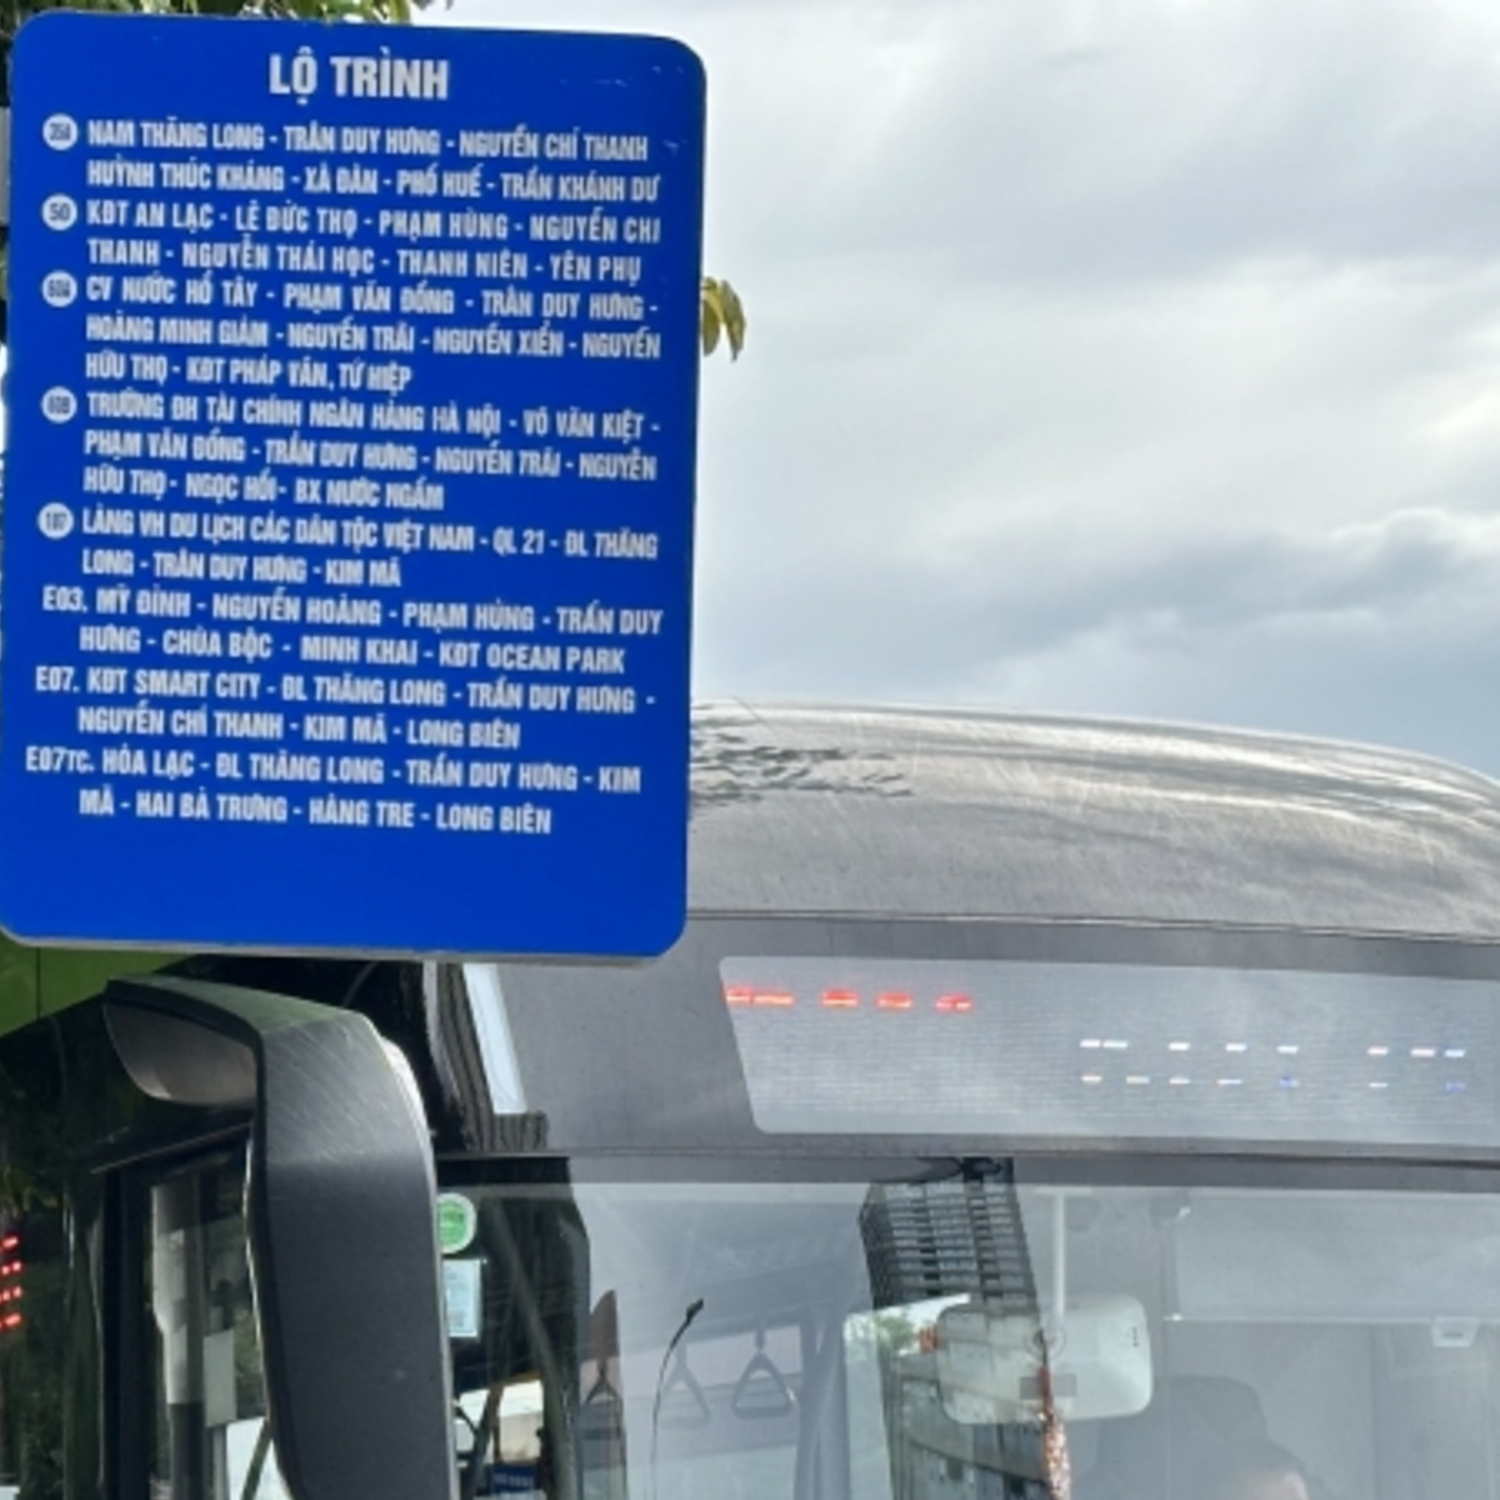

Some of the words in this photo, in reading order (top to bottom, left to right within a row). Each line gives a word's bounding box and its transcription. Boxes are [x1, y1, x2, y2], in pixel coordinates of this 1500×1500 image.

[269, 46, 319, 105] LỘ
[330, 46, 450, 102] TRÌNH
[87, 119, 137, 147] NAM
[212, 123, 266, 151] LONG
[341, 126, 382, 154] DUY
[583, 134, 649, 161] THANH
[87, 199, 129, 226] KĐT
[135, 202, 167, 228] AN
[86, 238, 161, 266] THANH
[396, 249, 469, 277] THANH
[86, 275, 114, 301] CV
[542, 292, 581, 318] DUY
[158, 317, 215, 345] MINH
[186, 356, 226, 383] KĐT
[170, 395, 200, 421] ĐH
[293, 478, 323, 504] BX
[139, 510, 167, 537] VH
[169, 512, 199, 538] DU
[428, 524, 476, 551] NAM
[493, 527, 519, 555] QL
[522, 529, 546, 555] 21
[565, 530, 590, 557] ĐL
[82, 548, 136, 576] LONG
[325, 559, 366, 585] KIM
[619, 609, 663, 635] DUY
[300, 635, 362, 663] MINH
[365, 638, 419, 665] KHAI
[439, 641, 481, 668] KĐT
[486, 643, 562, 671] OCEAN
[566, 646, 625, 674] PARK
[87, 666, 129, 694] KĐT
[133, 668, 211, 697] SMART
[215, 672, 262, 699] CITY
[281, 674, 310, 701] ĐL
[389, 679, 447, 707] LONG
[528, 684, 572, 711] DUY
[213, 710, 285, 739] THANH
[304, 714, 348, 741] KIM
[407, 719, 466, 747] LONG
[215, 752, 244, 779] ĐL
[326, 756, 385, 784] LONG
[469, 761, 513, 788] DUY
[599, 766, 642, 792] KIM
[136, 791, 175, 818] HAI
[374, 800, 415, 828] TRE
[436, 803, 495, 831] LONG
